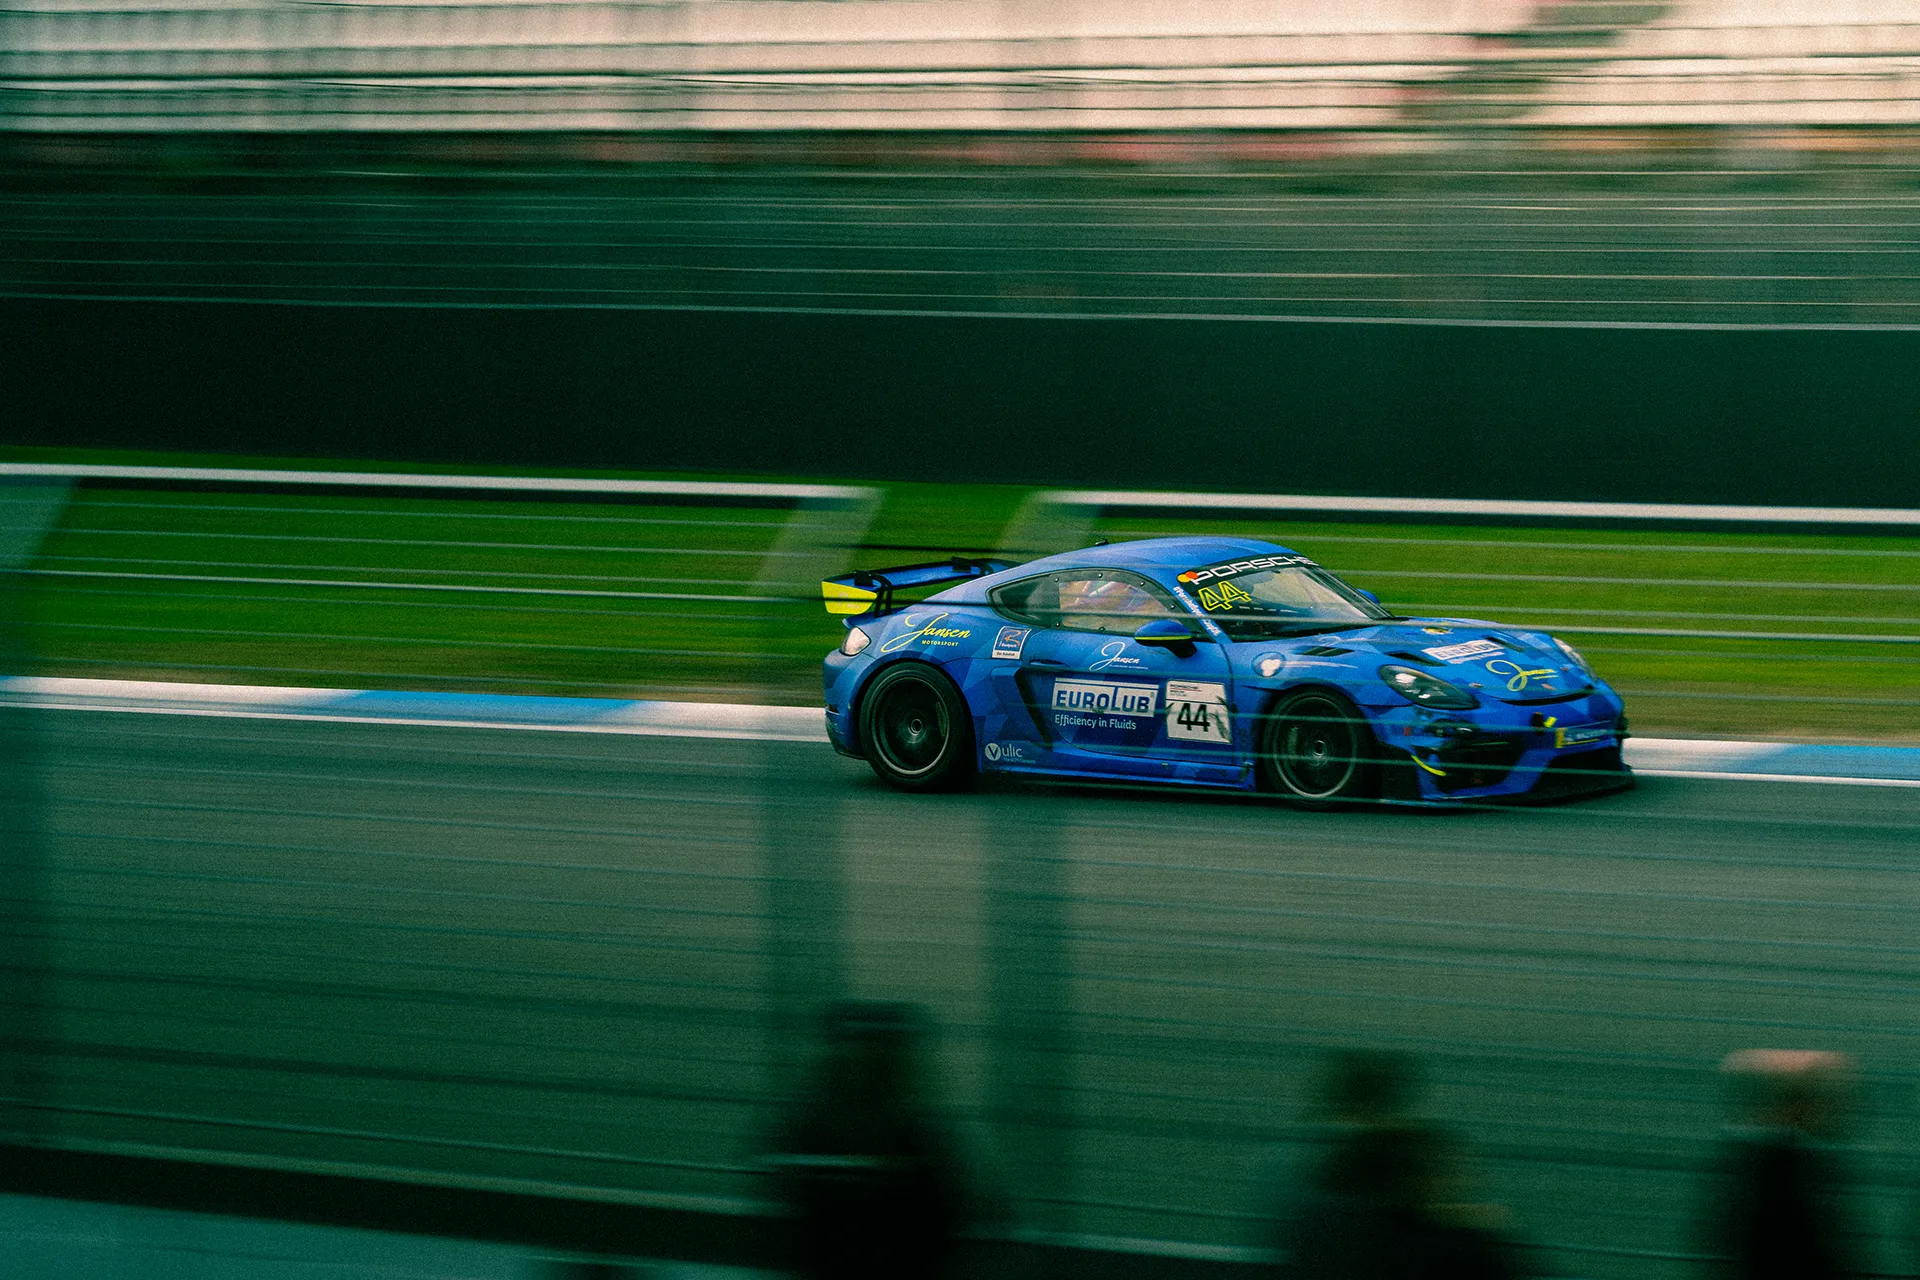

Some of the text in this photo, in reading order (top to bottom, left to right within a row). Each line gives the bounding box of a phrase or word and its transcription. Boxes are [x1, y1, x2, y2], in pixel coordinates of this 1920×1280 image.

[1189, 556, 1319, 586] PORSCHE
[1198, 580, 1252, 611] 44
[880, 612, 971, 653] Jansen
[1089, 641, 1140, 672] Jansen
[1055, 687, 1150, 713] EUROLUB
[1055, 714, 1137, 730] Efficiency in Fluids
[1177, 702, 1210, 733] 44
